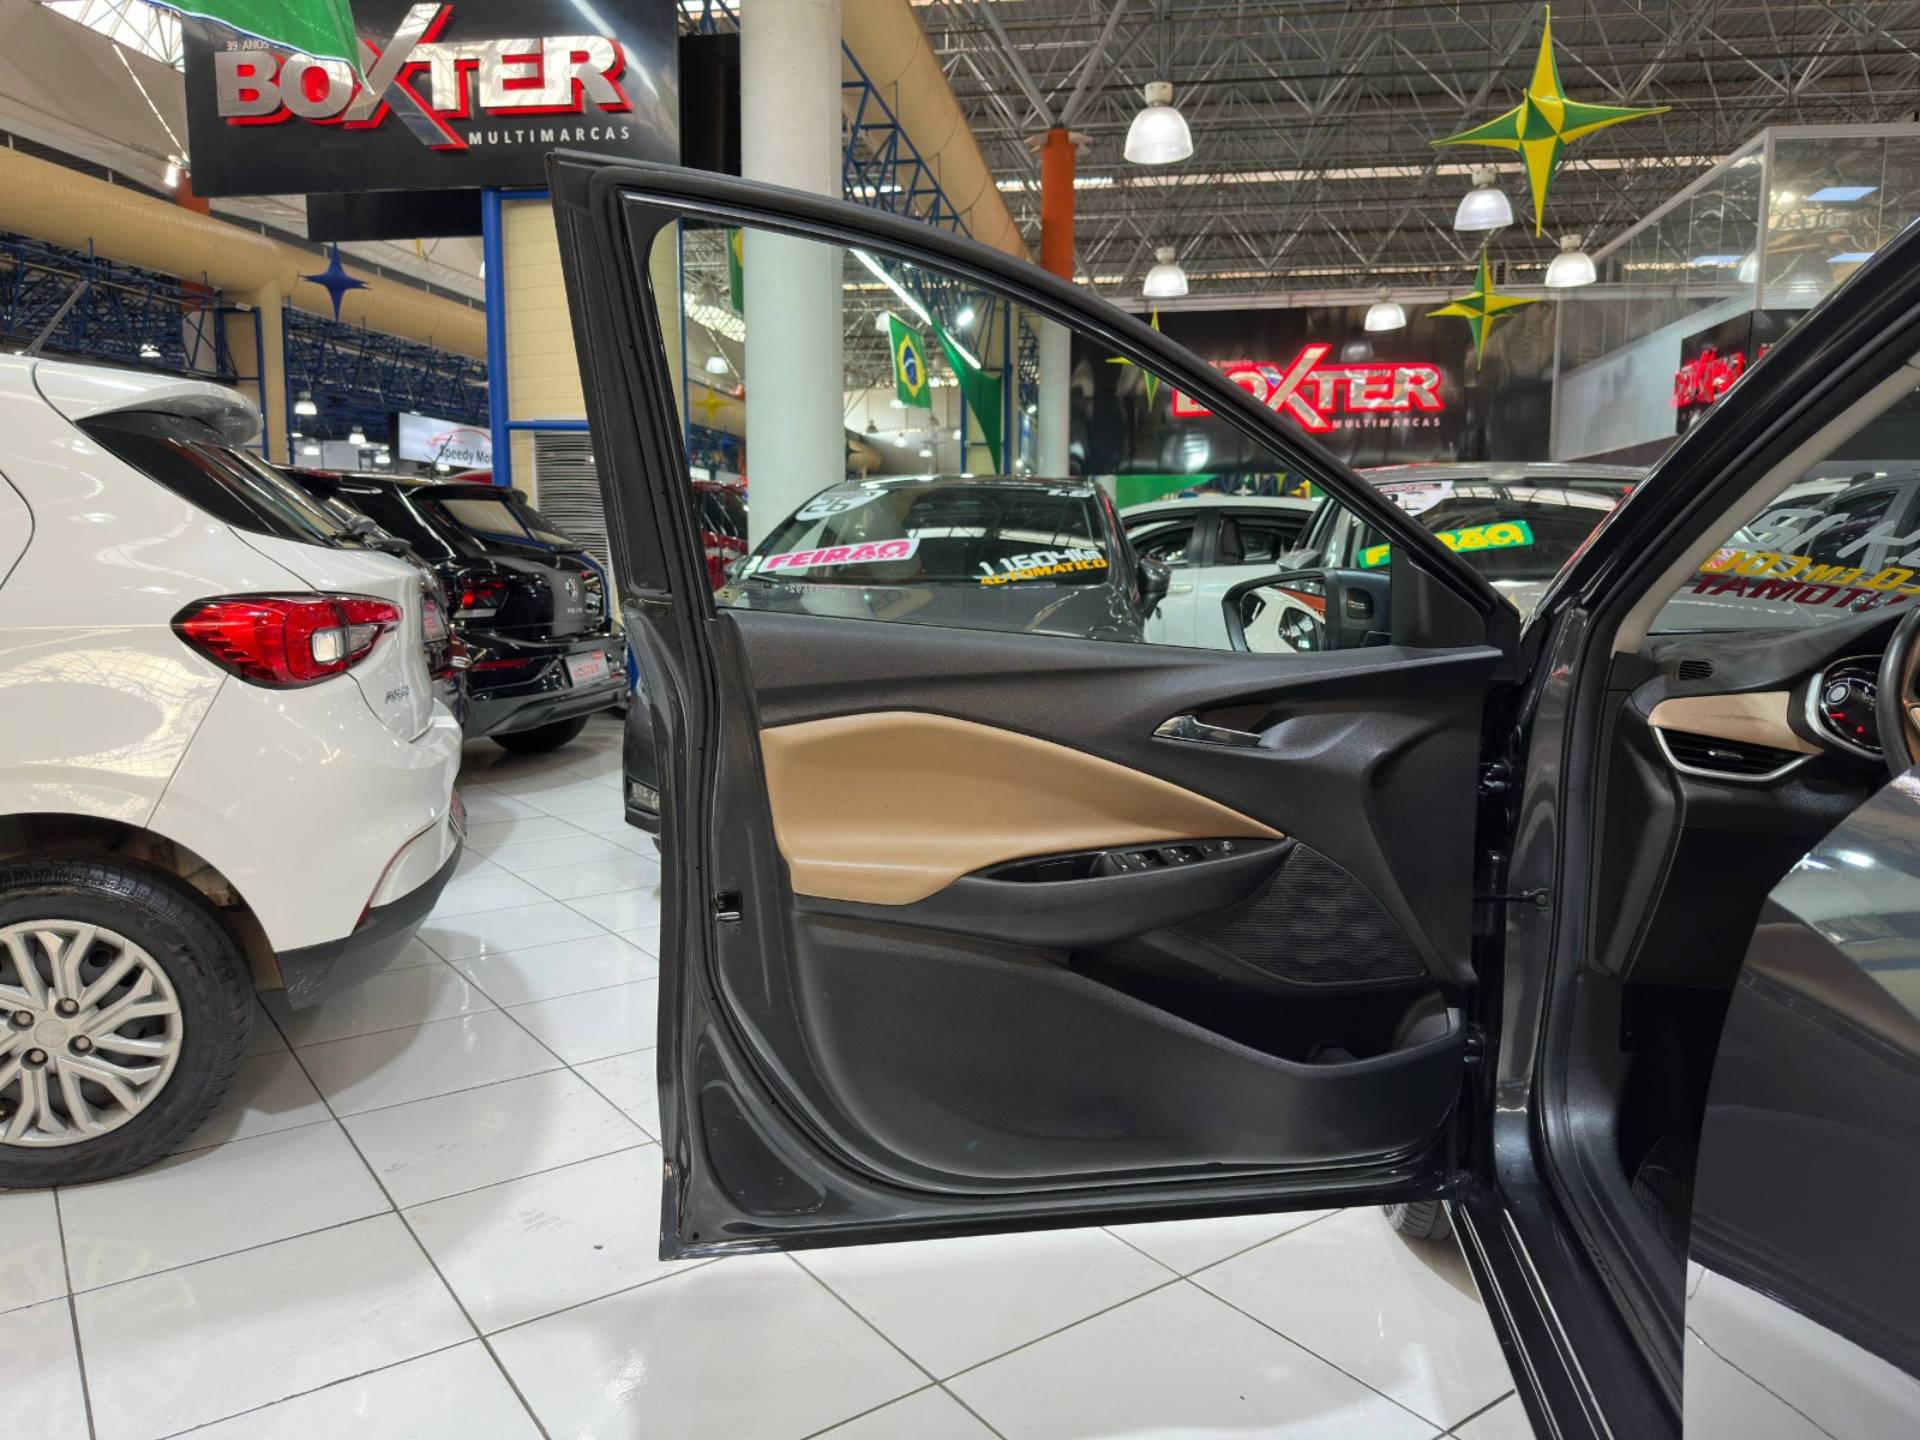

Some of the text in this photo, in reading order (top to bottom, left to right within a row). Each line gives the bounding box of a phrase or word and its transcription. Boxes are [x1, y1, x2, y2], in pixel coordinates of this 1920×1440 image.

[226, 38, 270, 51] 39 ANOS
[214, 3, 632, 150] BOXTER
[468, 126, 632, 146] MULTIMARCAS
[1172, 343, 1446, 432] OXTER
[1331, 416, 1442, 430] MULTIMARCAS
[440, 445, 493, 465] Speedy Mo
[766, 540, 911, 569] FEIRÃO
[1365, 522, 1524, 565] FRÃO
